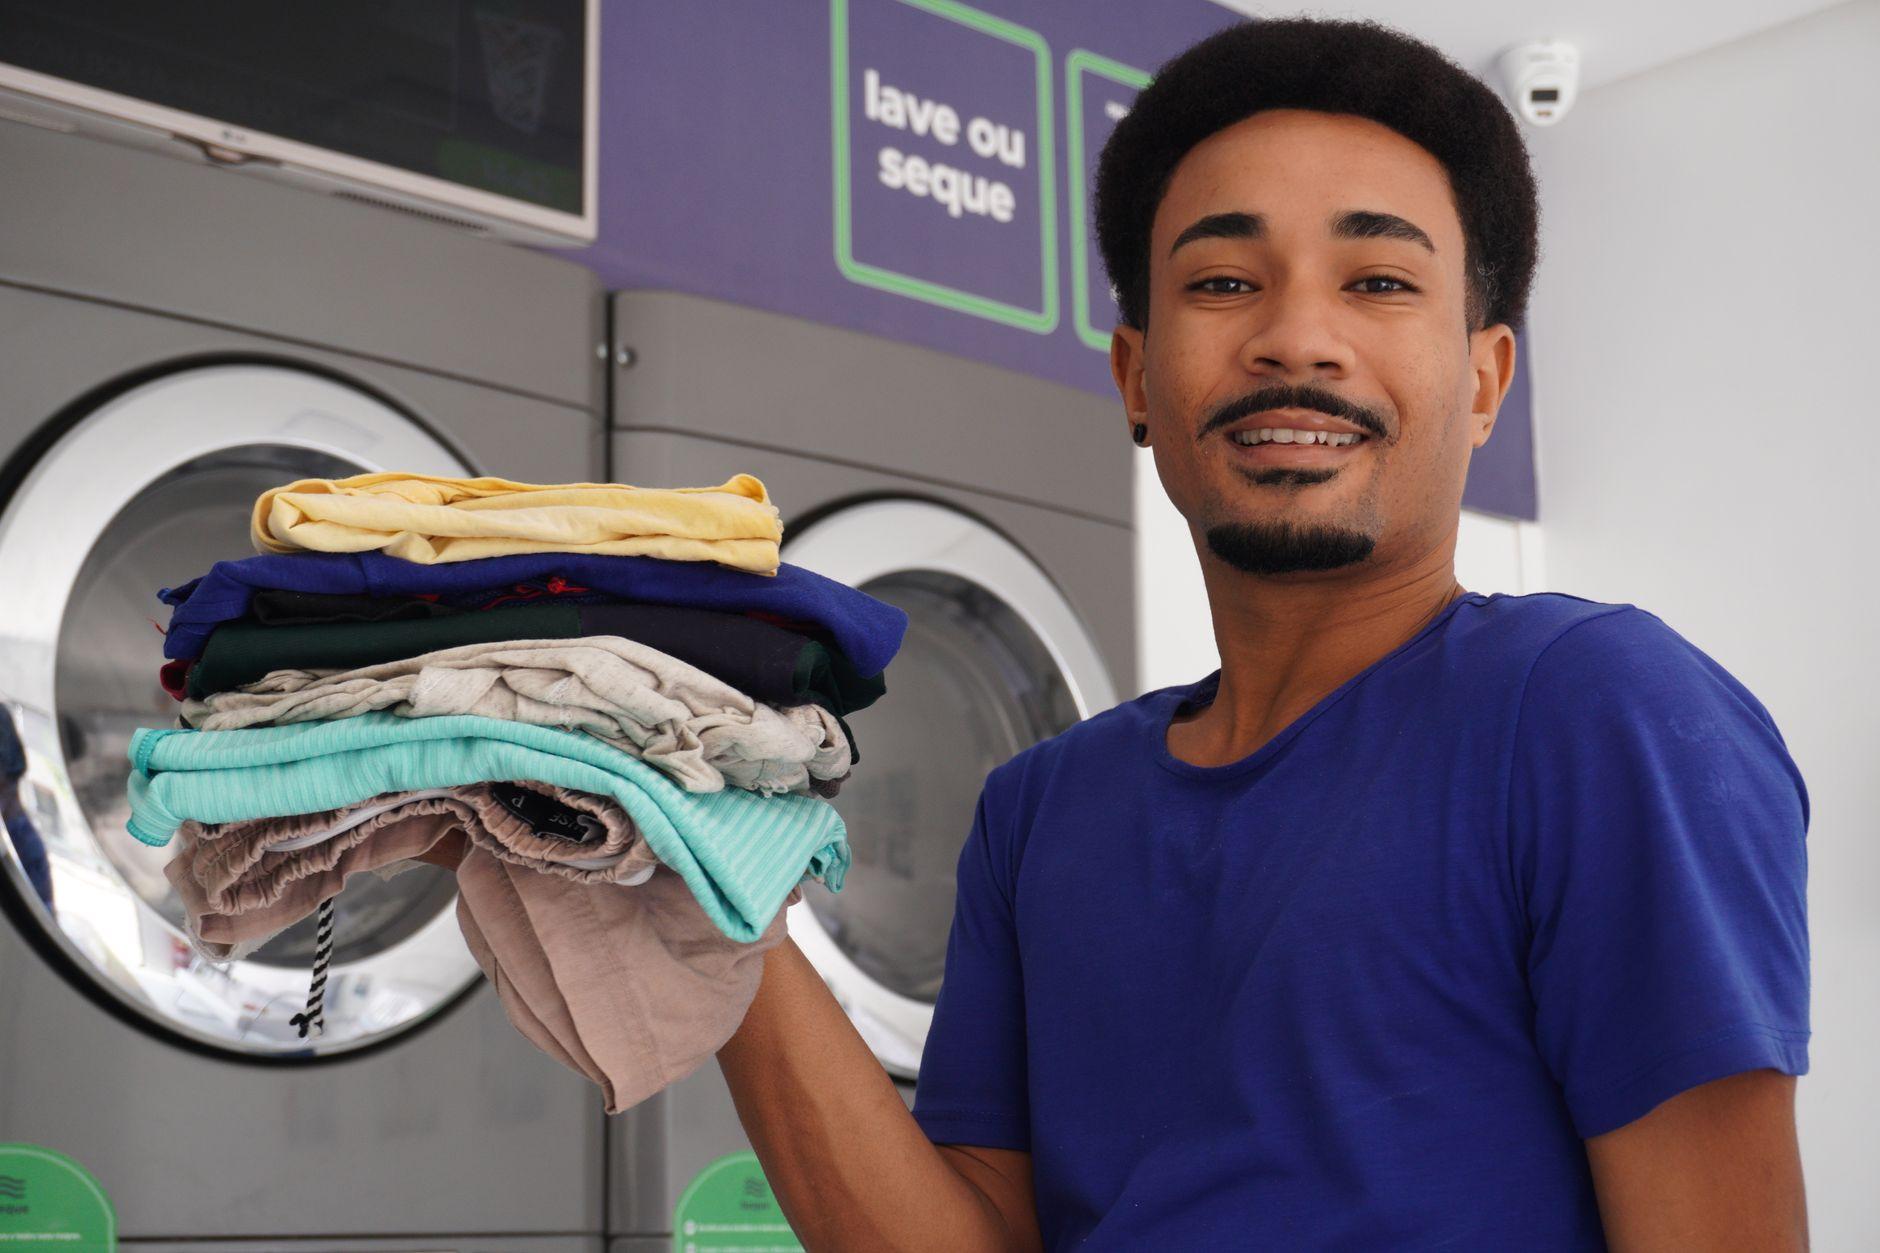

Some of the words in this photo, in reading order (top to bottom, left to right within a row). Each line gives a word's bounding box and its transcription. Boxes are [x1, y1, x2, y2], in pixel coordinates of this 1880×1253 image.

[863, 68, 960, 145] lave
[967, 117, 1026, 169] ou
[878, 146, 1015, 223] seque
